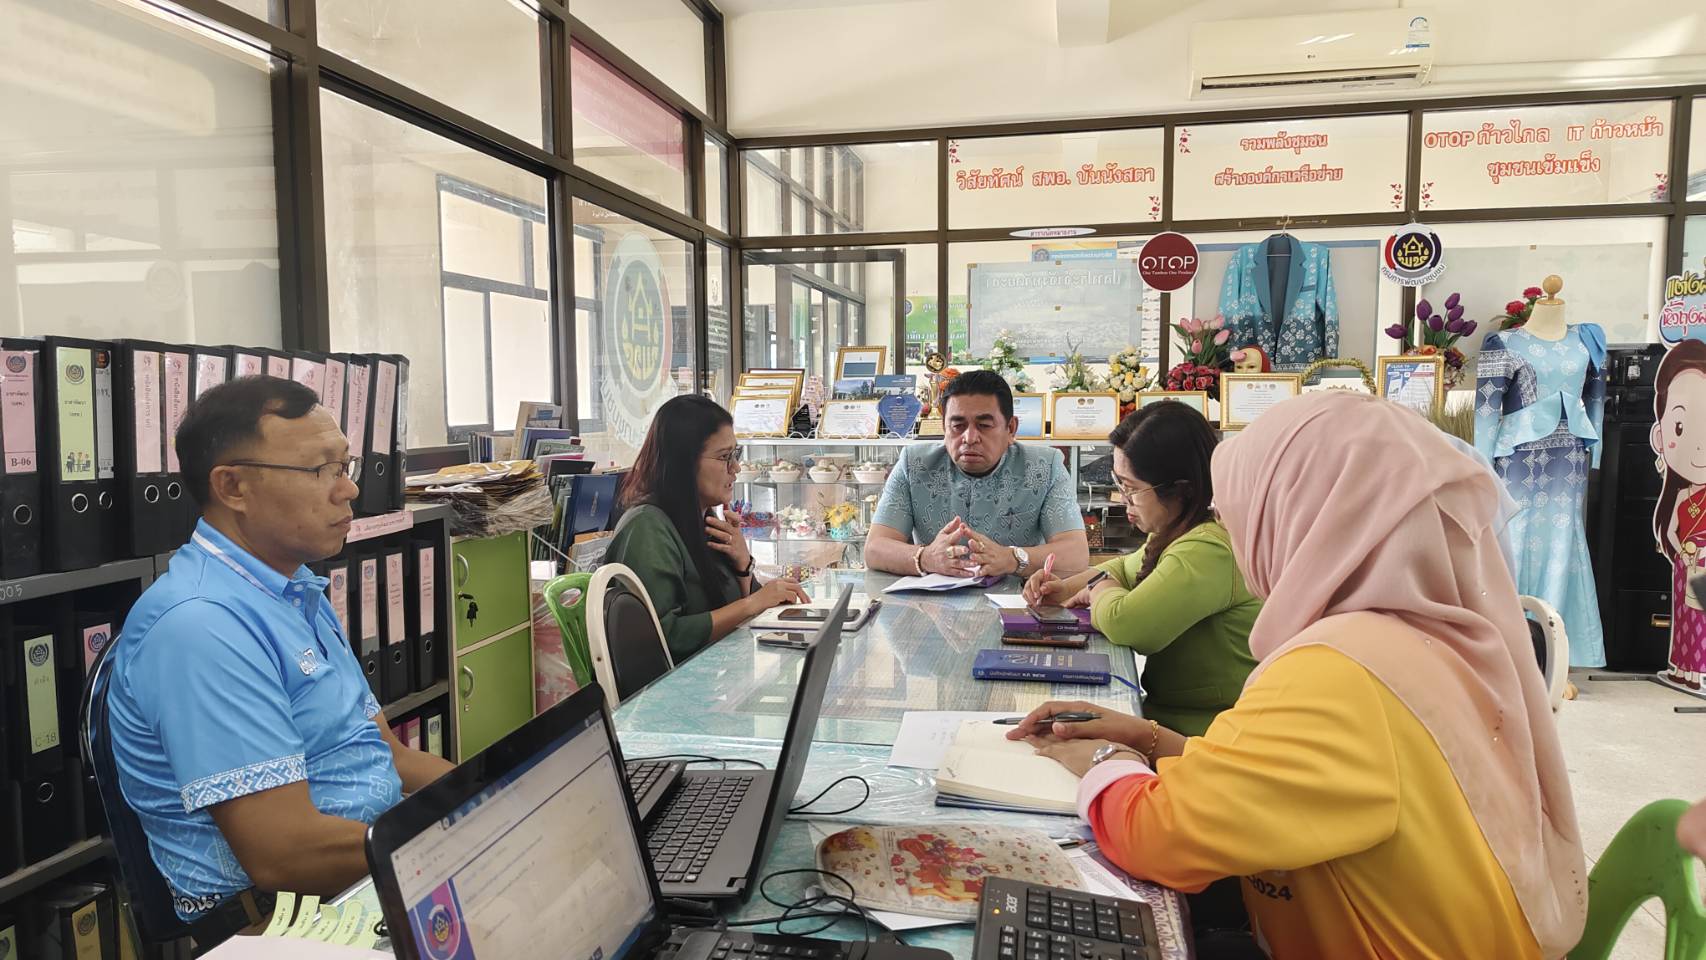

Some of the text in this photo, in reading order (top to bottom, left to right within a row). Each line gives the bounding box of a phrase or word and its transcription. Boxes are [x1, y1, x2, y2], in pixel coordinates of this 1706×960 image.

[1240, 131, 1328, 155] รวมพลังชุมชน
[1424, 116, 1664, 148] OTOP ก้าวไกล IT ก้าวหน้า
[956, 163, 1155, 190] วิสัยทัศน์ สพอ. บันนังสตา
[1214, 164, 1343, 186] สร้างองค์กรเครือข่าย
[1487, 150, 1600, 184] ชุมชนเข้มแข็ง
[1142, 256, 1194, 269] OTOP
[11, 458, 31, 467] B-06
[1006, 893, 1018, 914] acer
